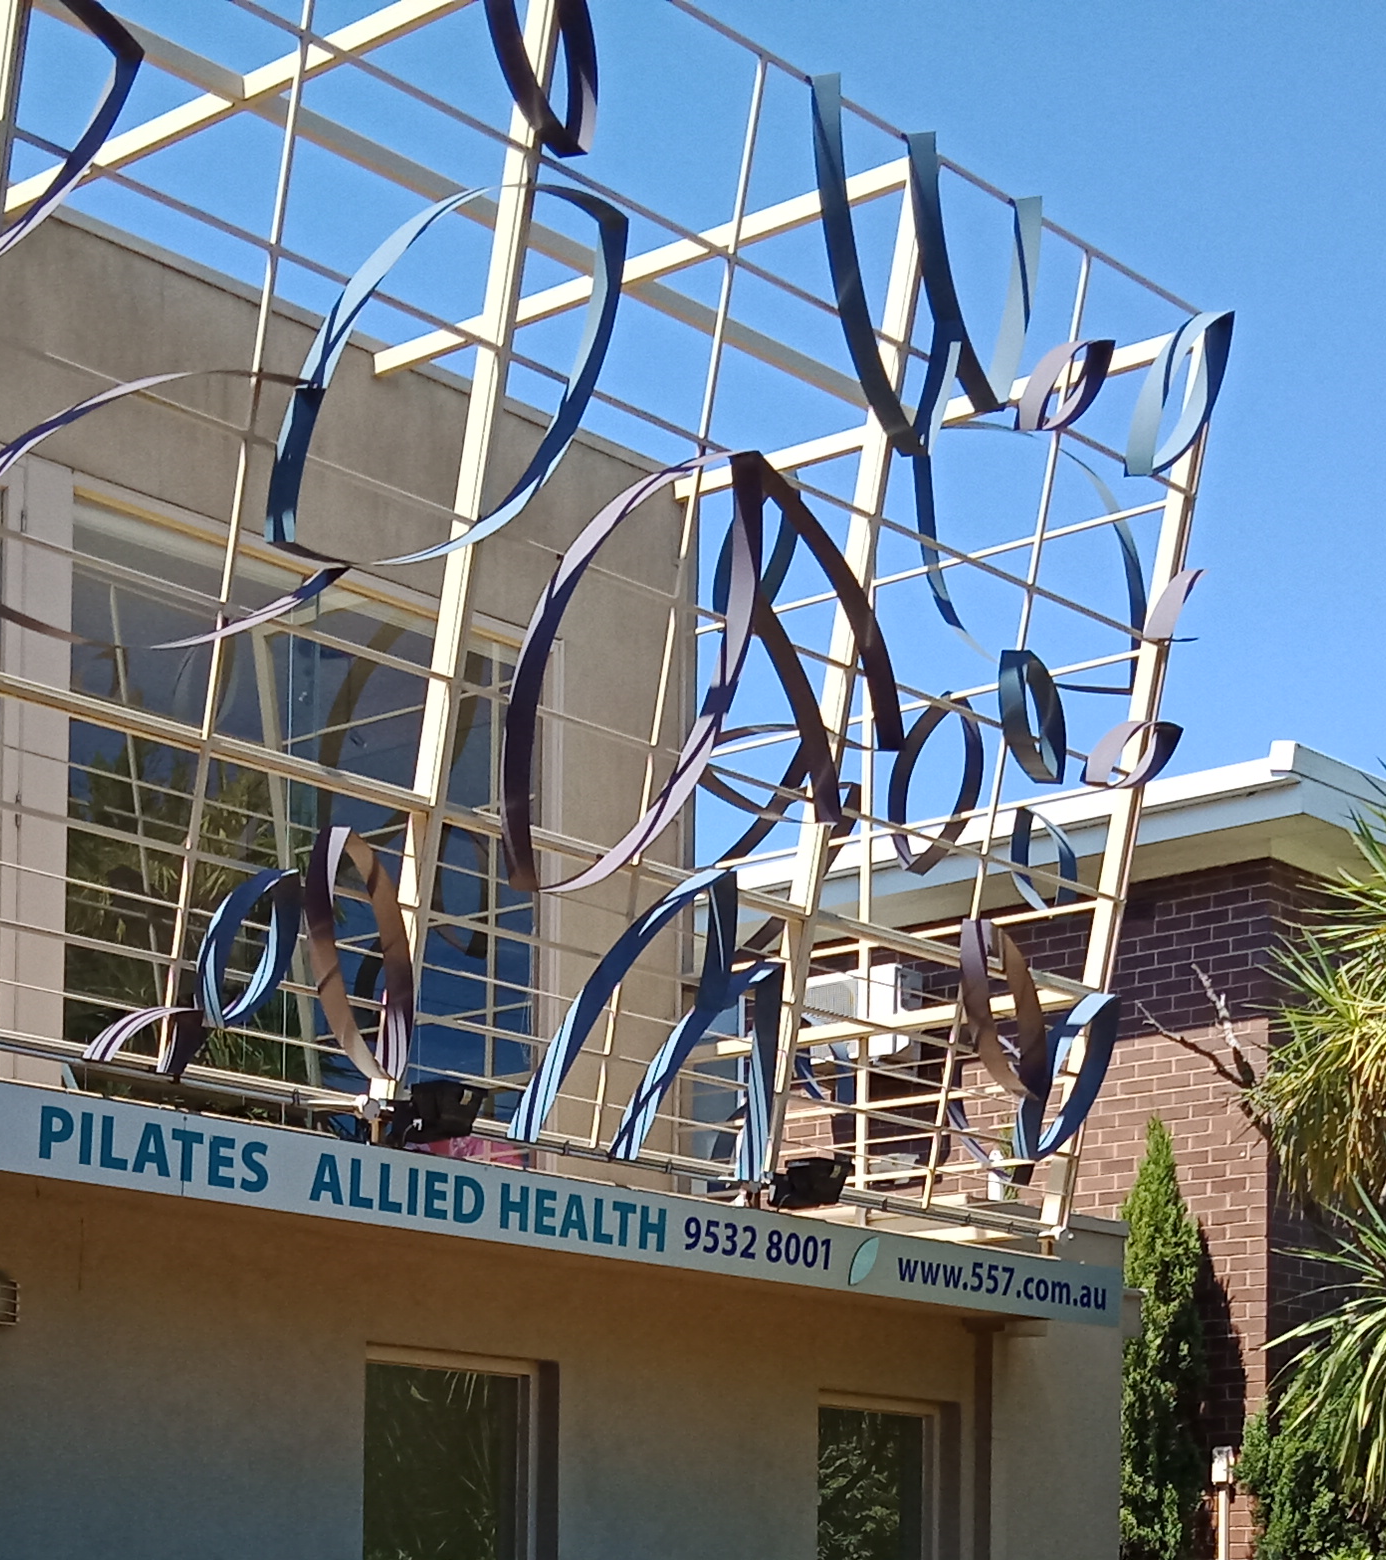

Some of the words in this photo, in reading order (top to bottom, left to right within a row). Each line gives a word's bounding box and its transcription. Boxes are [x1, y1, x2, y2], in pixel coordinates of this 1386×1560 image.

[38, 1106, 269, 1193] PILATES
[309, 1153, 485, 1224] ALLIED
[500, 1183, 666, 1252] HEALTH
[684, 1217, 756, 1260] 9532
[766, 1229, 831, 1270] 8001
[897, 1256, 1107, 1311] www.557.com.au
